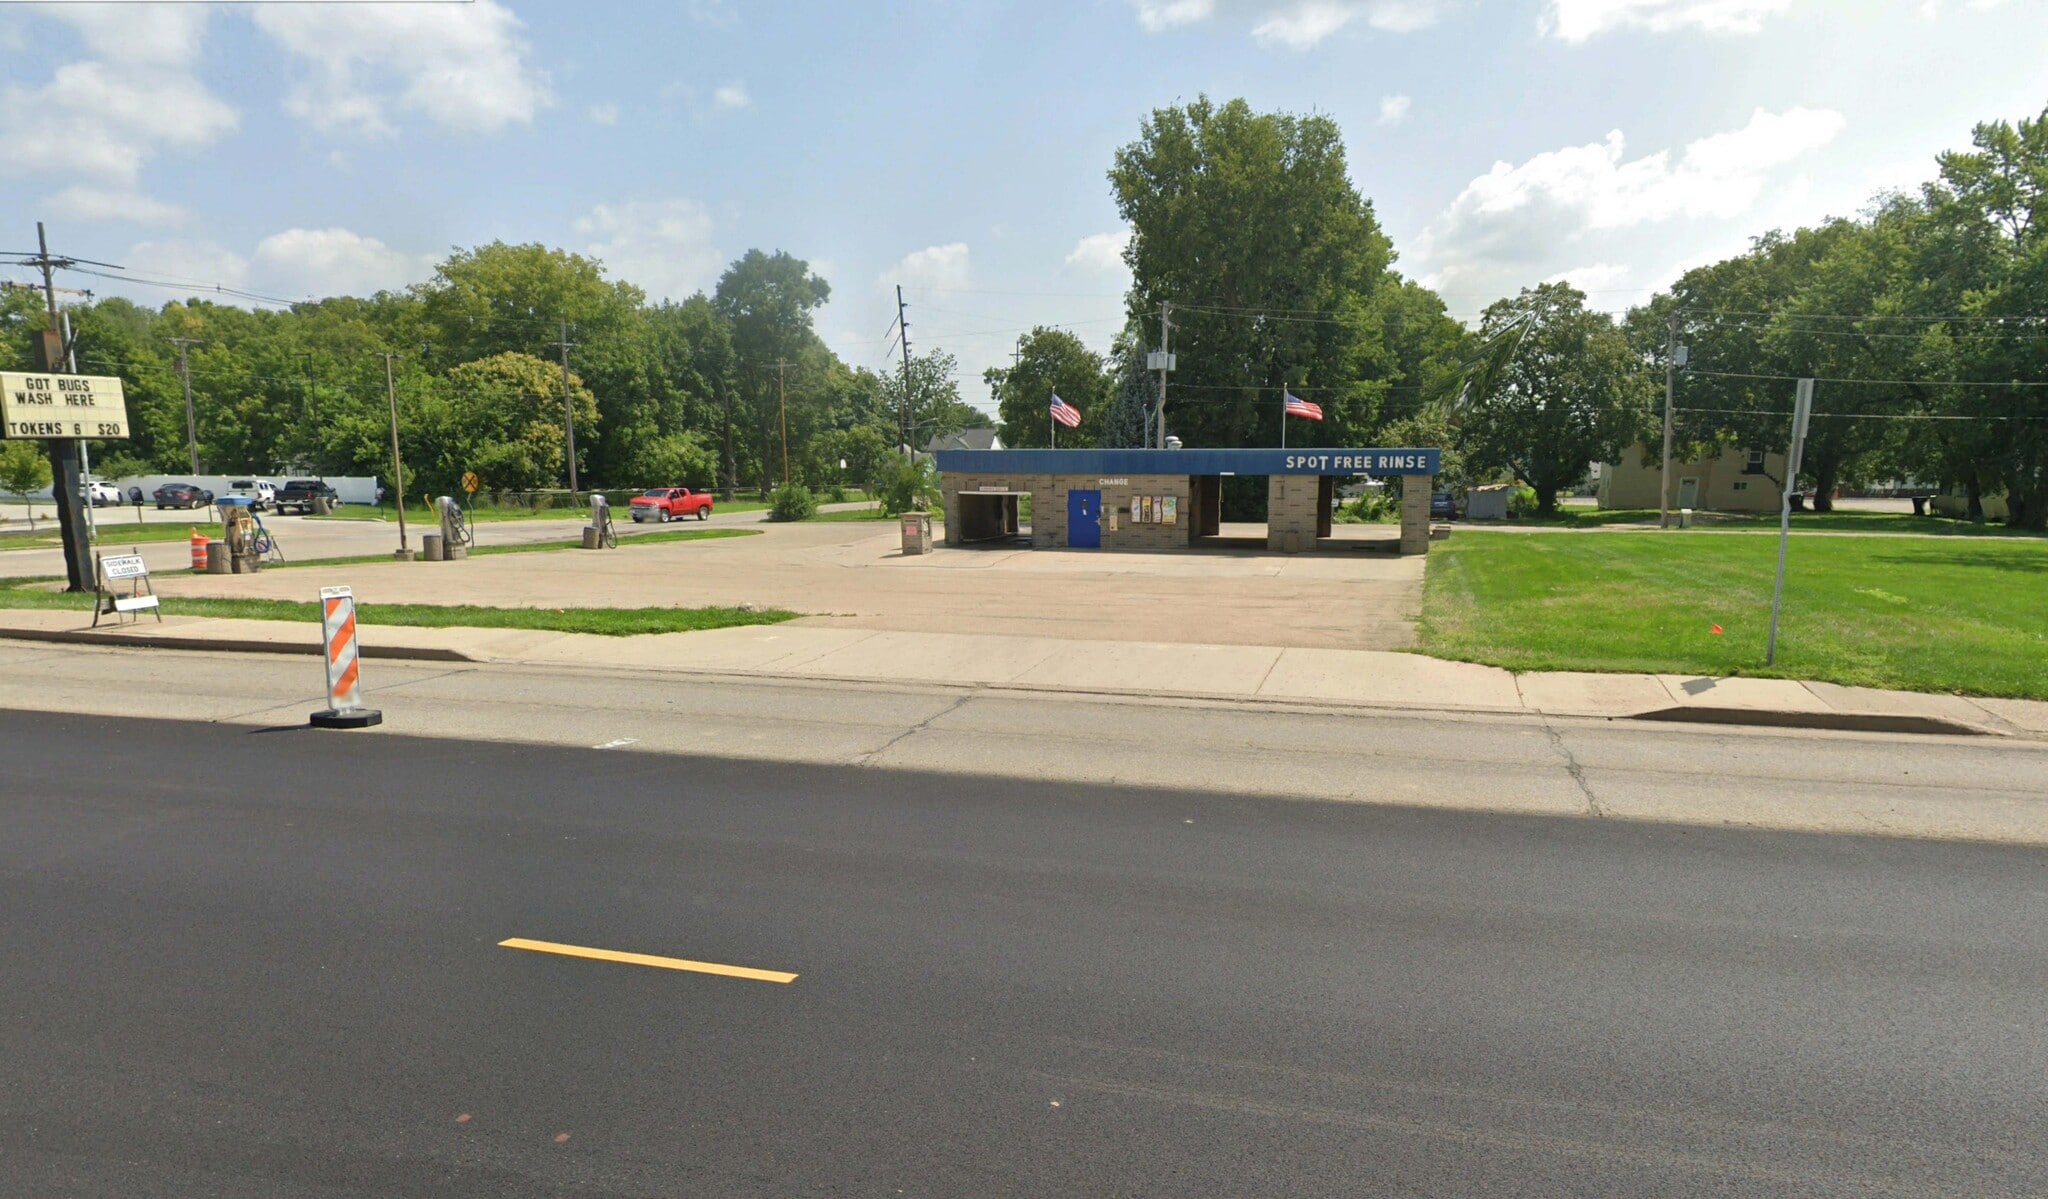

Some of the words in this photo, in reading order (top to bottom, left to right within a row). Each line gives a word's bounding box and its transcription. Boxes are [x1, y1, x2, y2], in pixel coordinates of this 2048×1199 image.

[26, 377, 50, 390] GOT
[58, 379, 90, 392] BUGS
[15, 392, 53, 405] WASH
[65, 393, 95, 406] HERE
[9, 422, 62, 435] TOKENS
[74, 423, 81, 435] 6
[1286, 455, 1329, 470] SPOT
[1334, 455, 1372, 469] FREE
[1378, 455, 1427, 469] RINSE
[1099, 478, 1129, 486] CHANGE
[105, 558, 141, 567] SIDEWALK
[111, 566, 139, 575] CLOSED
